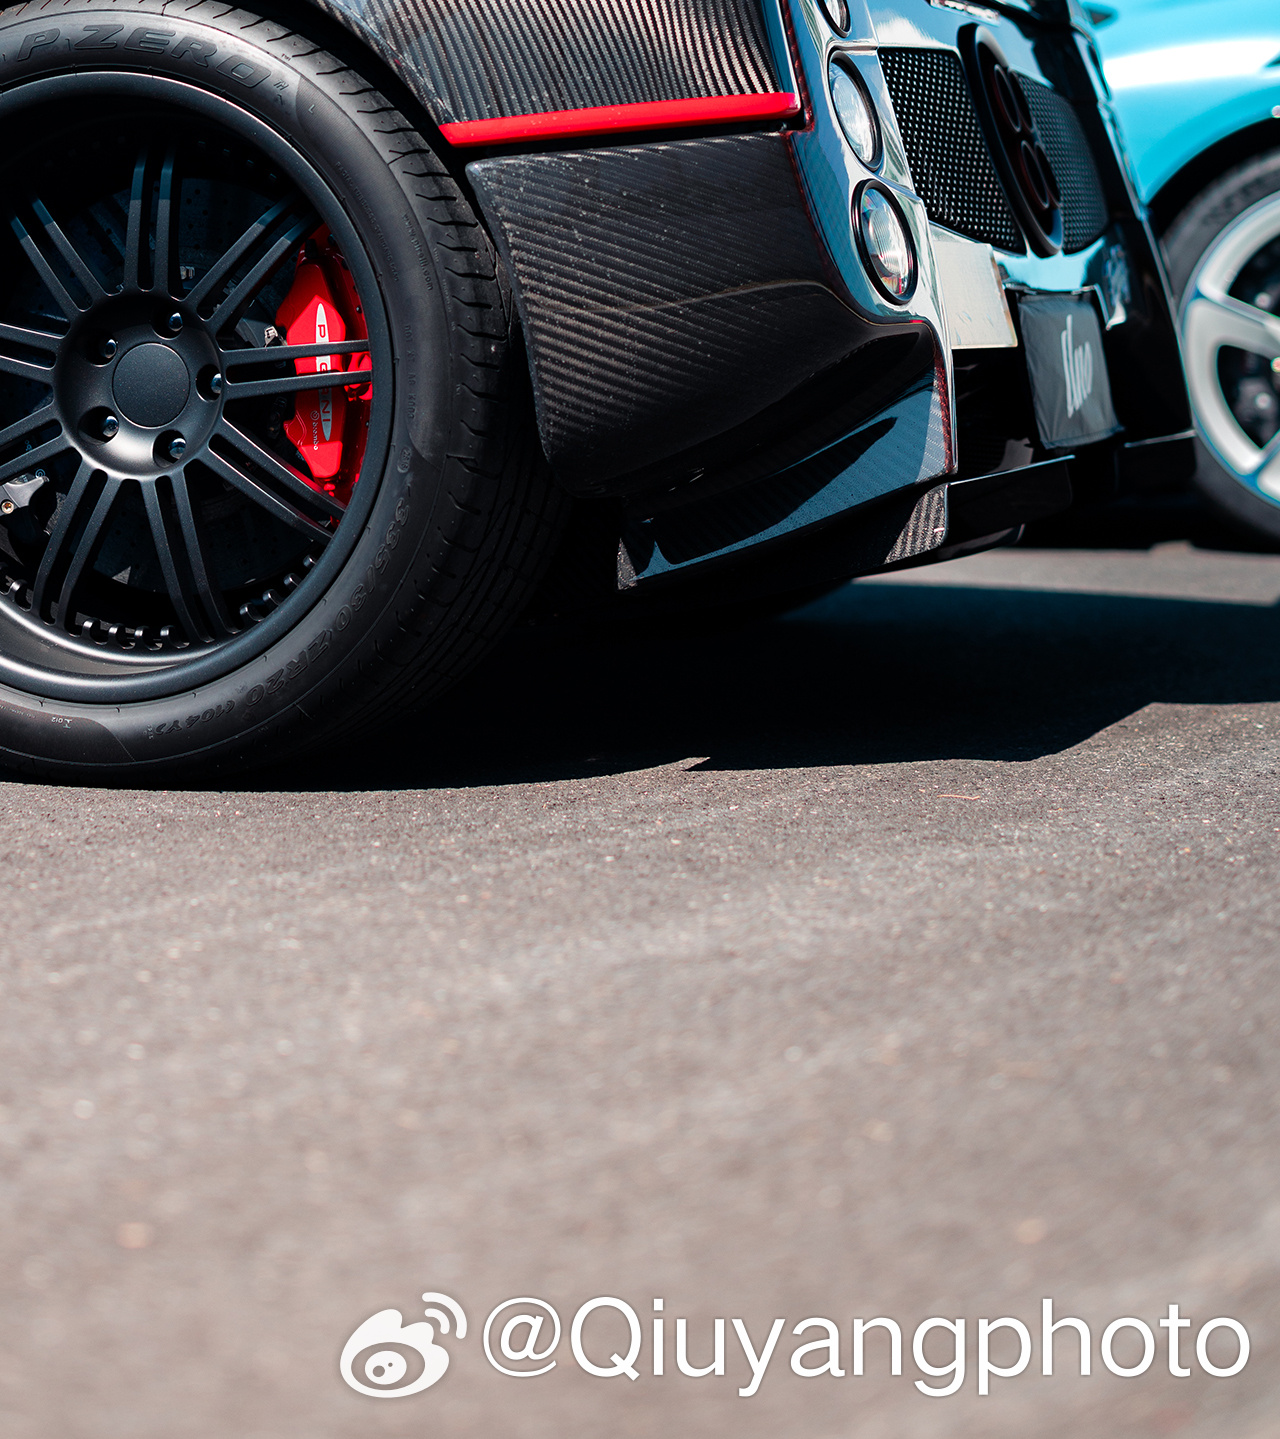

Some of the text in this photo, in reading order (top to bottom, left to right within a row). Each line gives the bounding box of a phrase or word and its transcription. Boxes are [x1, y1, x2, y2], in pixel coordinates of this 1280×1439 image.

[16, 28, 61, 62] P
[73, 24, 272, 89] ZERO
[402, 214, 433, 290] www.pirelli.com
